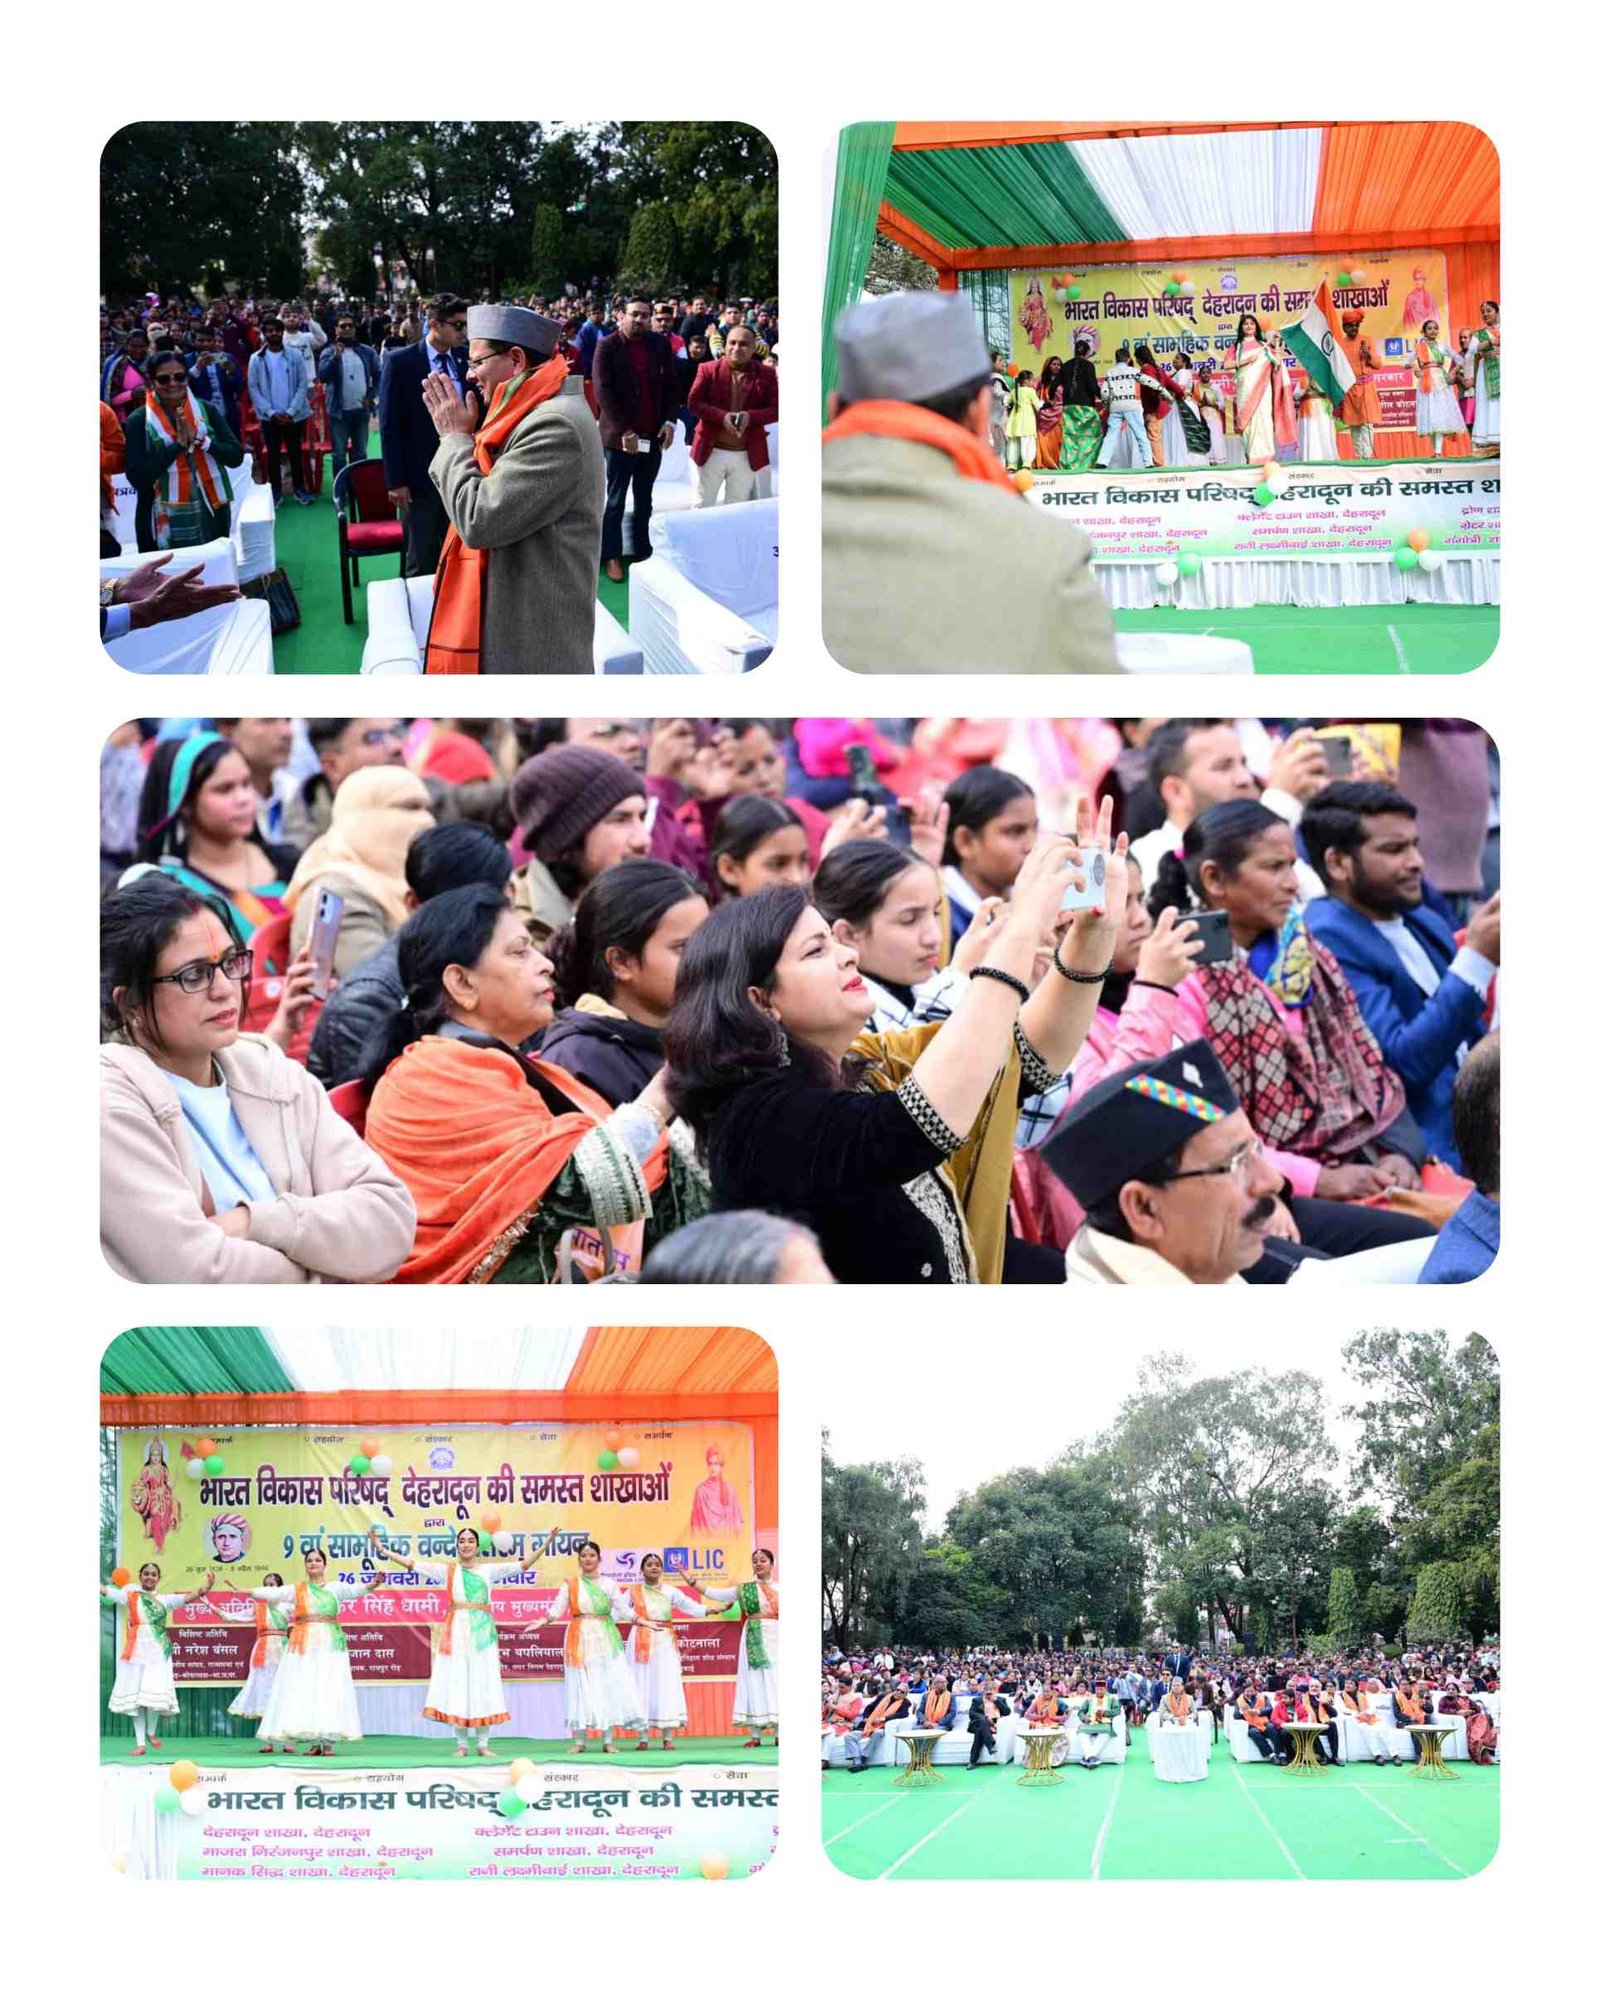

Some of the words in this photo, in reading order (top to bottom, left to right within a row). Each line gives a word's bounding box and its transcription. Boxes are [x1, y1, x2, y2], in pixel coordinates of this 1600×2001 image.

[1064, 299, 1101, 320] भारत
[1103, 291, 1149, 319] विकास
[1260, 283, 1280, 313] की
[1332, 279, 1390, 310] शाखाओं
[1042, 491, 1100, 506] भारत
[1106, 486, 1180, 505] विकास
[1360, 477, 1398, 498] की
[1400, 480, 1475, 497] समस्त
[200, 1477, 251, 1506] भारत
[256, 1464, 323, 1506] विकास
[329, 1463, 394, 1518] परिषद्
[401, 1465, 481, 1520] देहरादून
[487, 1463, 514, 1505] की
[520, 1474, 583, 1503] समस्त
[590, 1462, 673, 1503] शाखाओं
[693, 1547, 725, 1571] LIC
[363, 1590, 394, 1616] सिंह
[184, 1642, 209, 1656] नरेश
[212, 1643, 239, 1655] बंसल
[375, 1648, 395, 1659] दास
[366, 1772, 405, 1785] सहयोग
[544, 1772, 580, 1783] संस्कार
[726, 1770, 749, 1781] सेवा
[207, 1791, 286, 1811] भारत
[296, 1784, 398, 1811] विकास
[405, 1783, 507, 1818] परिषद्
[640, 1782, 682, 1808] की
[203, 1825, 260, 1842] देहरादून
[313, 1826, 371, 1842] देहरादून
[525, 1825, 561, 1837] टाउन
[614, 1824, 673, 1840] देहरादून
[251, 1844, 323, 1862] निरंजनपुर
[376, 1845, 434, 1861] देहरादून
[493, 1842, 543, 1857] समर्पण
[596, 1844, 655, 1860] देहरादून
[202, 1867, 246, 1877] मानक
[338, 1864, 396, 1880] देहरादून
[469, 1862, 498, 1876] रानी
[621, 1863, 680, 1879] देहरादून
